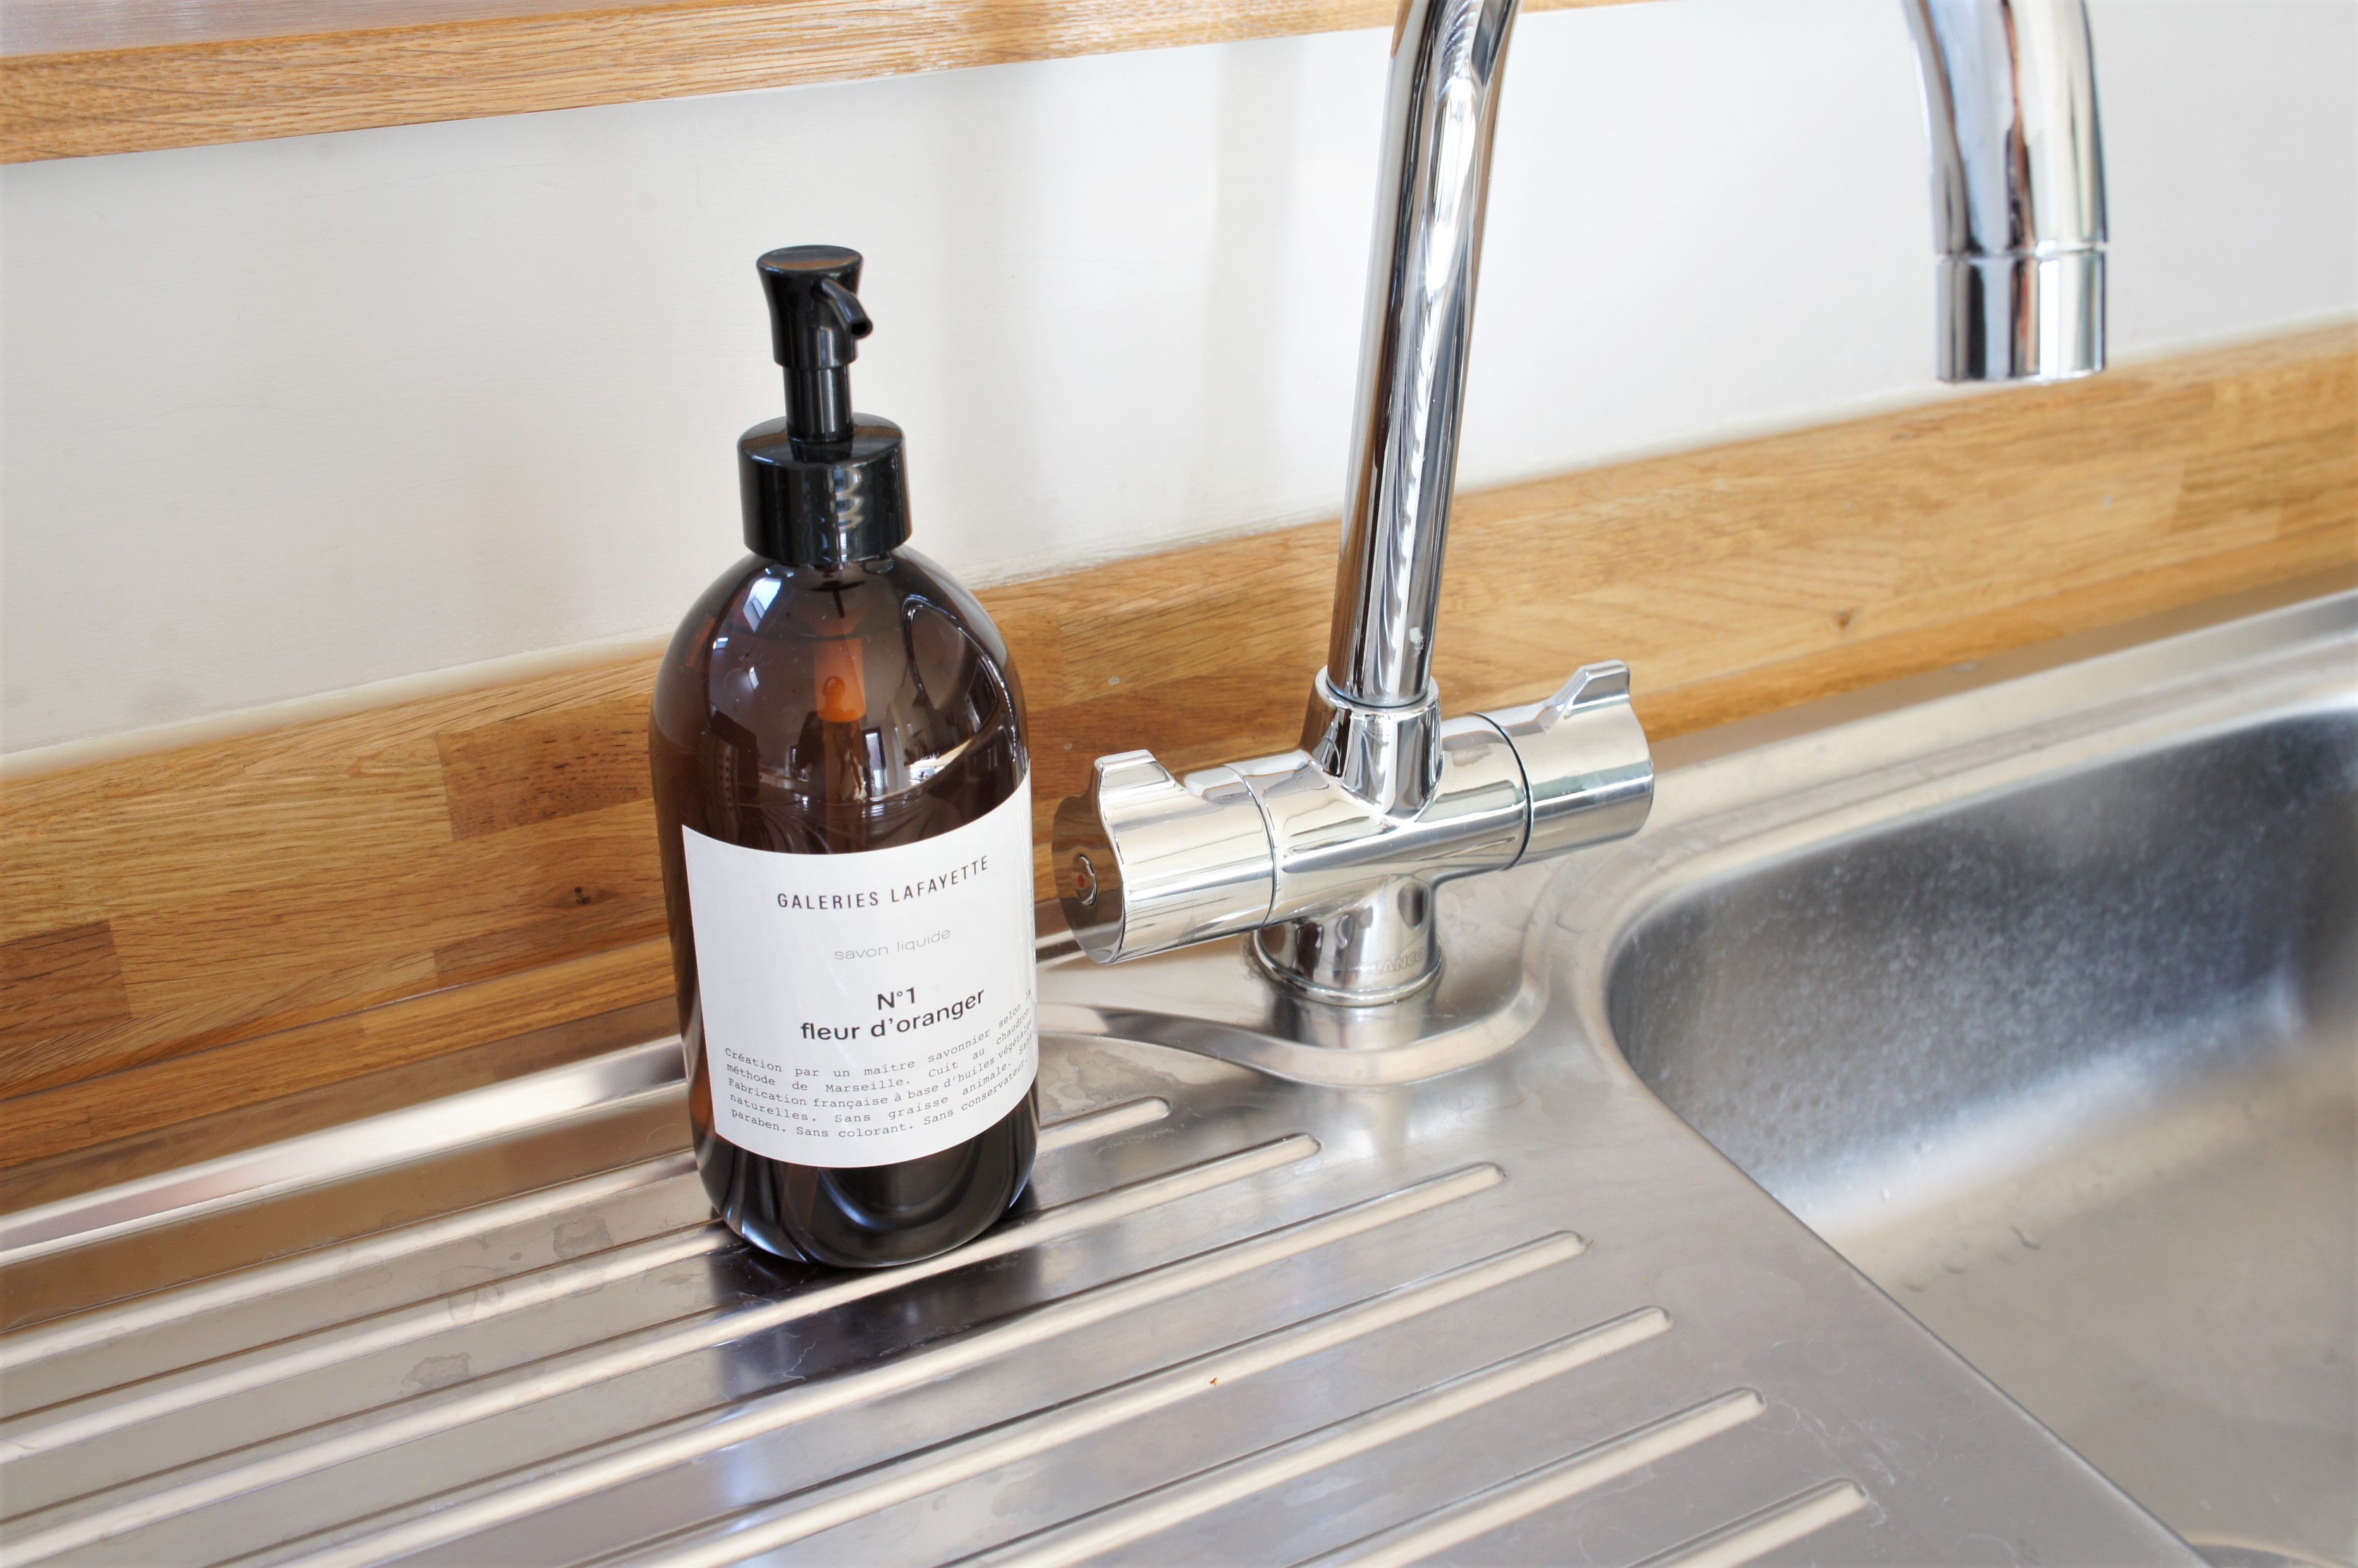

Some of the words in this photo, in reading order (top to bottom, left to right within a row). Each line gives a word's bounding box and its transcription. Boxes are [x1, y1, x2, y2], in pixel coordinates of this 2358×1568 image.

[777, 893, 879, 909] GALERIES
[891, 855, 988, 903] LAFAYETTE
[834, 945, 889, 960] savon
[896, 929, 951, 952] liquide
[800, 1022, 860, 1040] fleur
[870, 988, 984, 1037] d'oranger
[877, 986, 916, 1010] N°1
[725, 1048, 782, 1072] Création
[795, 1067, 819, 1077] par
[864, 1060, 915, 1076] maître
[928, 1029, 990, 1062] savonnier
[998, 1003, 1021, 1029] selon
[726, 1063, 776, 1086] méthode
[792, 1081, 808, 1091] de
[825, 1079, 910, 1092] Marseille.
[928, 1060, 958, 1077] Cuit
[972, 1048, 985, 1060] au
[728, 1077, 807, 1106] Fabrication
[814, 1097, 888, 1110] française
[894, 1093, 902, 1102] à
[908, 1083, 939, 1099] base
[943, 1057, 995, 1088] d'huiles
[730, 1094, 816, 1122] naturelles.
[835, 1114, 872, 1123] Sans
[888, 1096, 948, 1120] graisse
[962, 1062, 1011, 1096] animale.
[731, 1108, 786, 1132] paraben.
[796, 1126, 829, 1138] Sans
[838, 1123, 913, 1138] colorant.
[924, 1109, 953, 1126] Sans
[961, 1058, 1027, 1111] conservateur.
